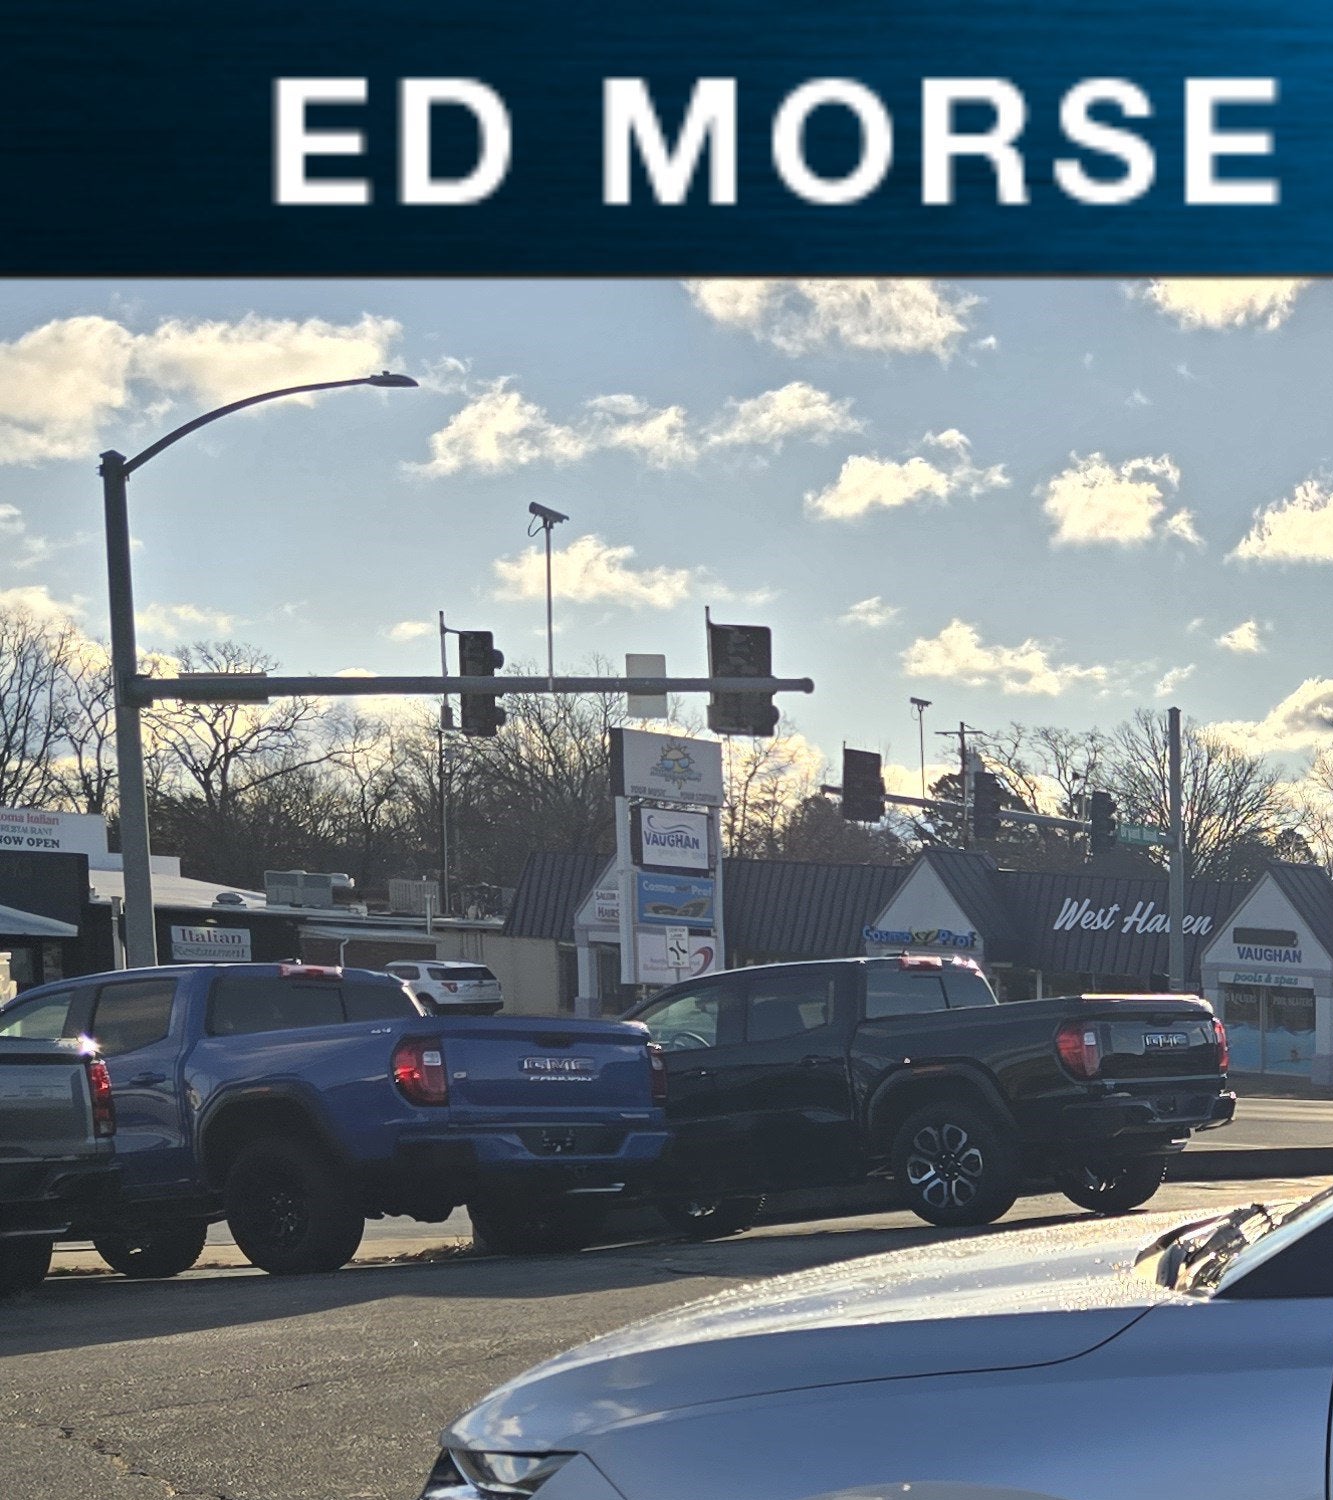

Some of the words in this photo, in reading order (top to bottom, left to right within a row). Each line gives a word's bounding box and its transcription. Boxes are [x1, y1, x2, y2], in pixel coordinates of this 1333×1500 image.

[27, 836, 60, 850] OPEN
[643, 830, 701, 851] VAUGHAN
[1053, 897, 1120, 931] West
[1122, 900, 1214, 936] Haen
[180, 928, 242, 944] Italian
[862, 924, 912, 945] Cosmo
[938, 928, 977, 947] Prof
[1236, 945, 1303, 964] VAUGHAN
[1232, 972, 1263, 985] pools
[1264, 973, 1273, 984] &
[1274, 975, 1299, 987] spas
[522, 1056, 596, 1072] GMC
